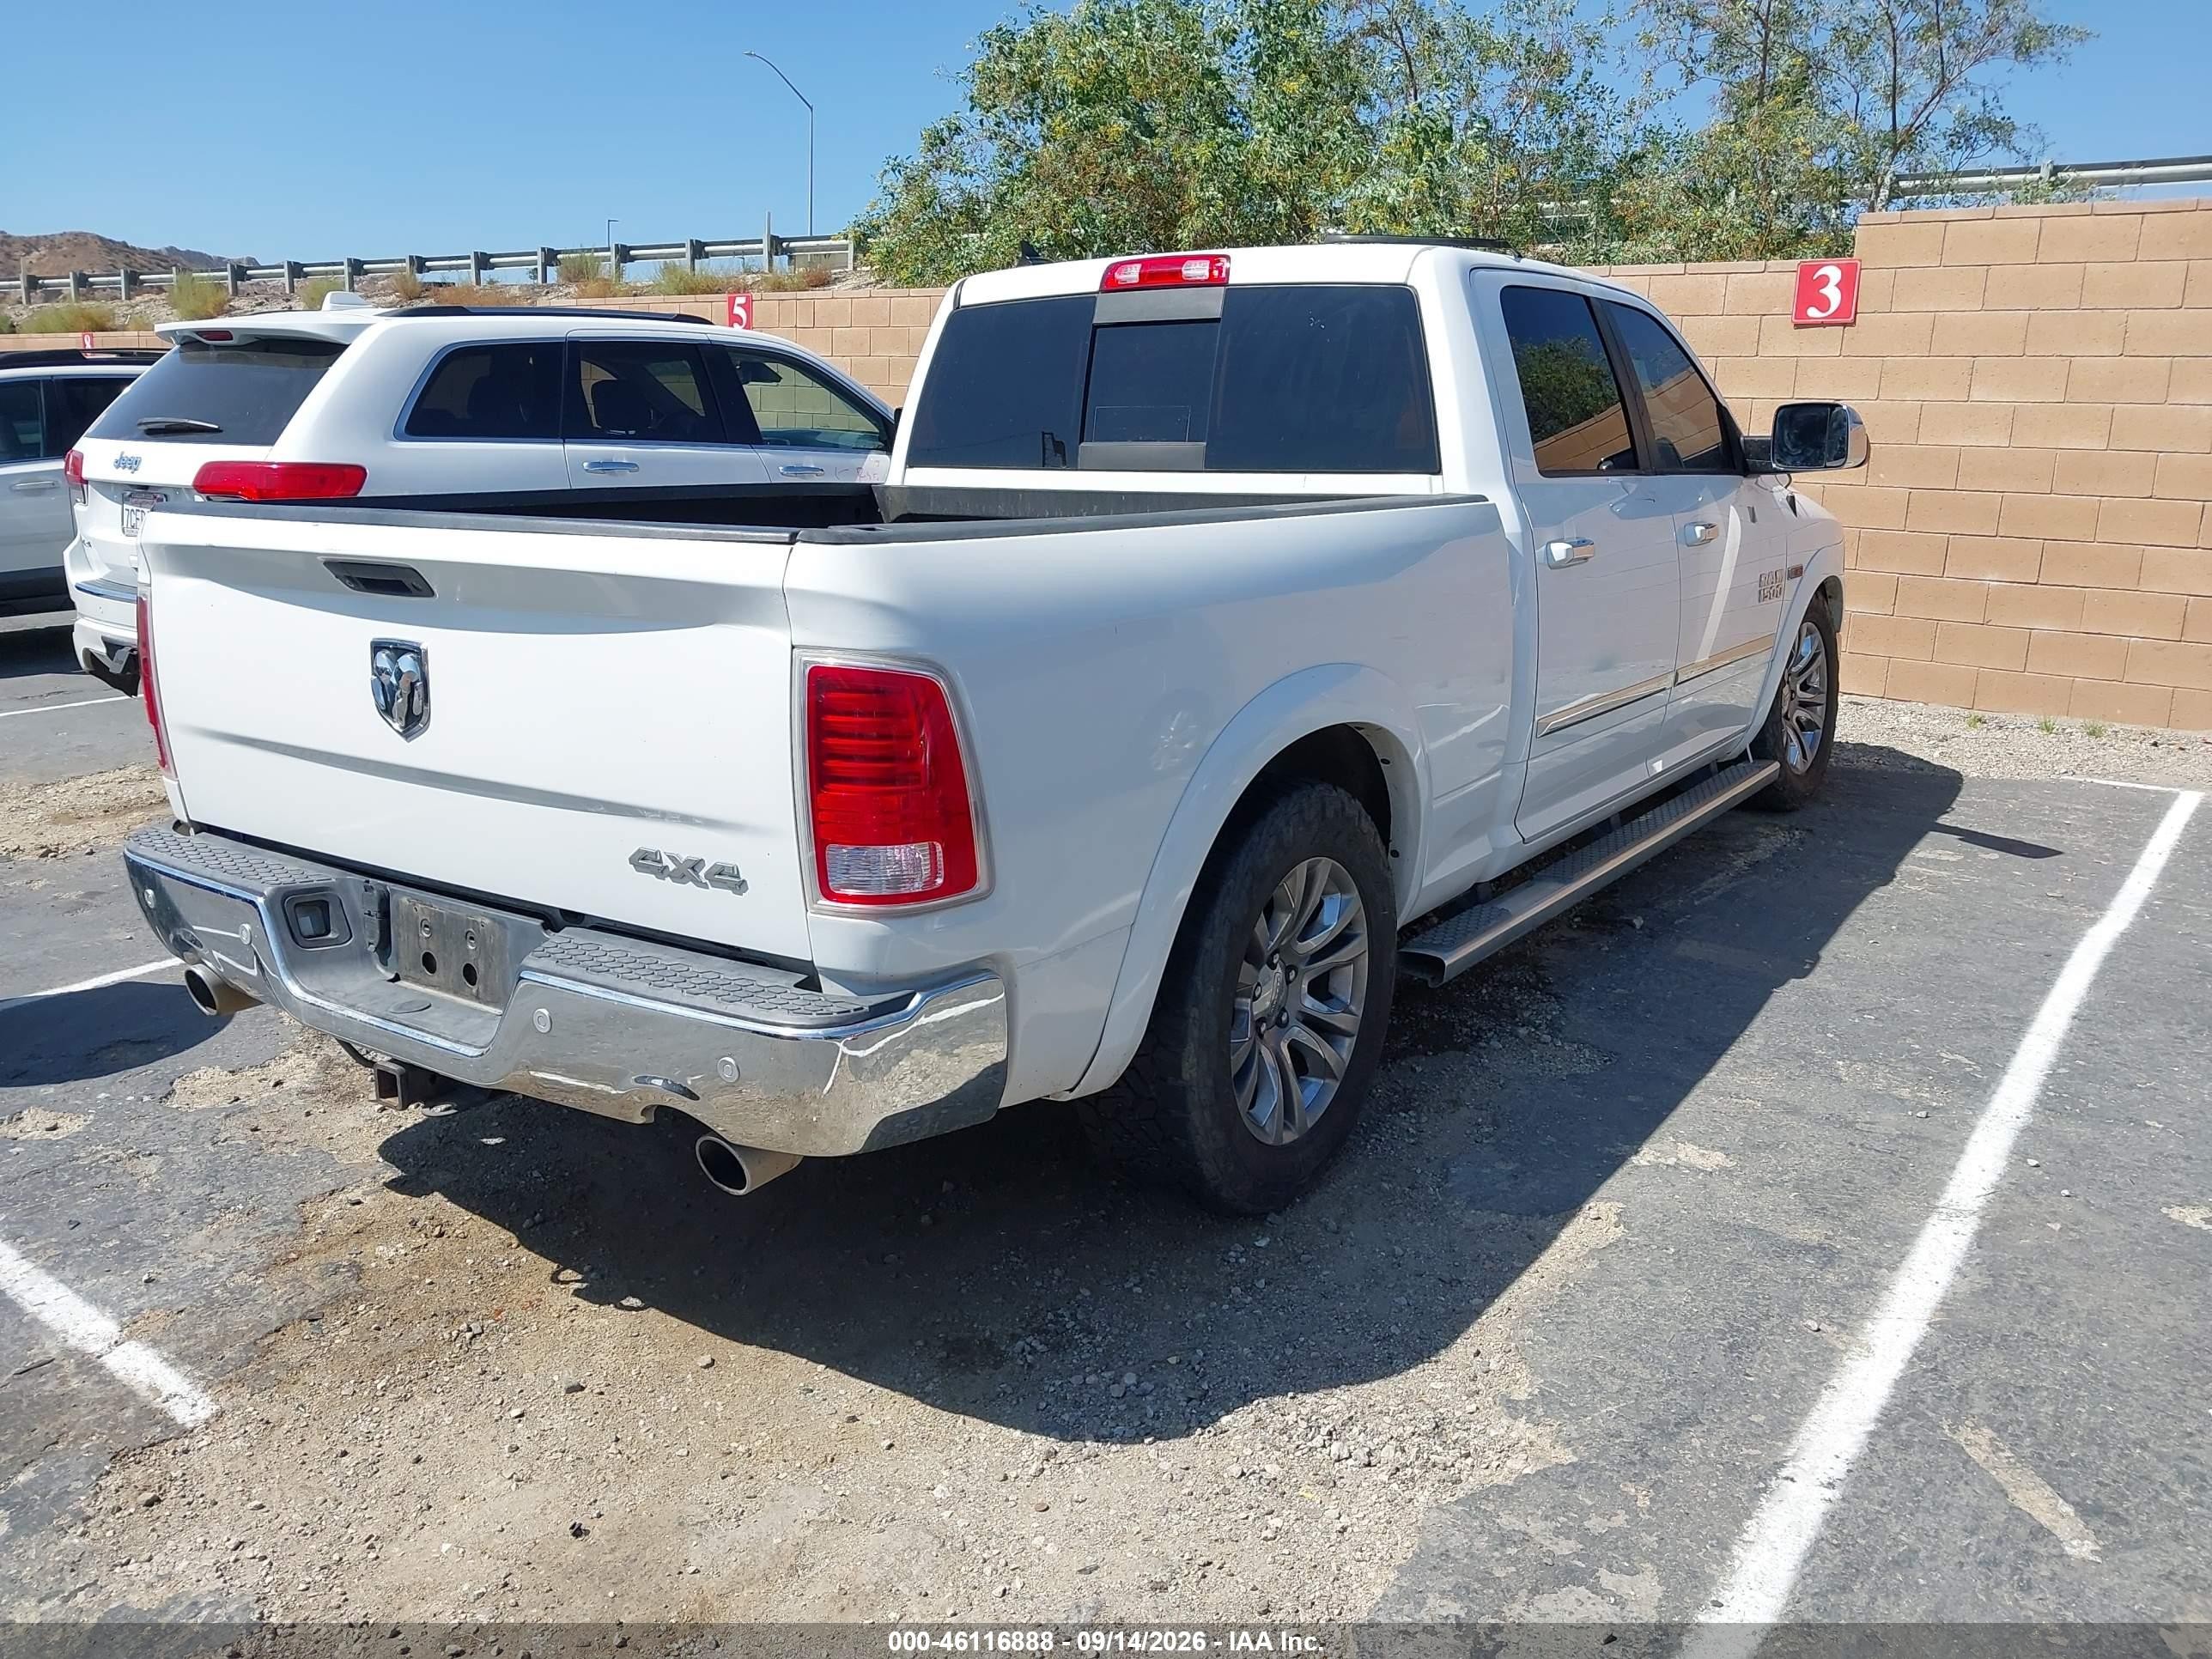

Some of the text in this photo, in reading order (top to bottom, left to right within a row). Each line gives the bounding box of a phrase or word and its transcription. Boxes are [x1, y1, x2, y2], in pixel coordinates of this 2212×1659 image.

[1807, 264, 1842, 319] 3
[732, 296, 747, 330] 5
[113, 451, 142, 474] Jeep
[1759, 569, 1784, 587] RAM
[1758, 583, 1784, 603] 1500
